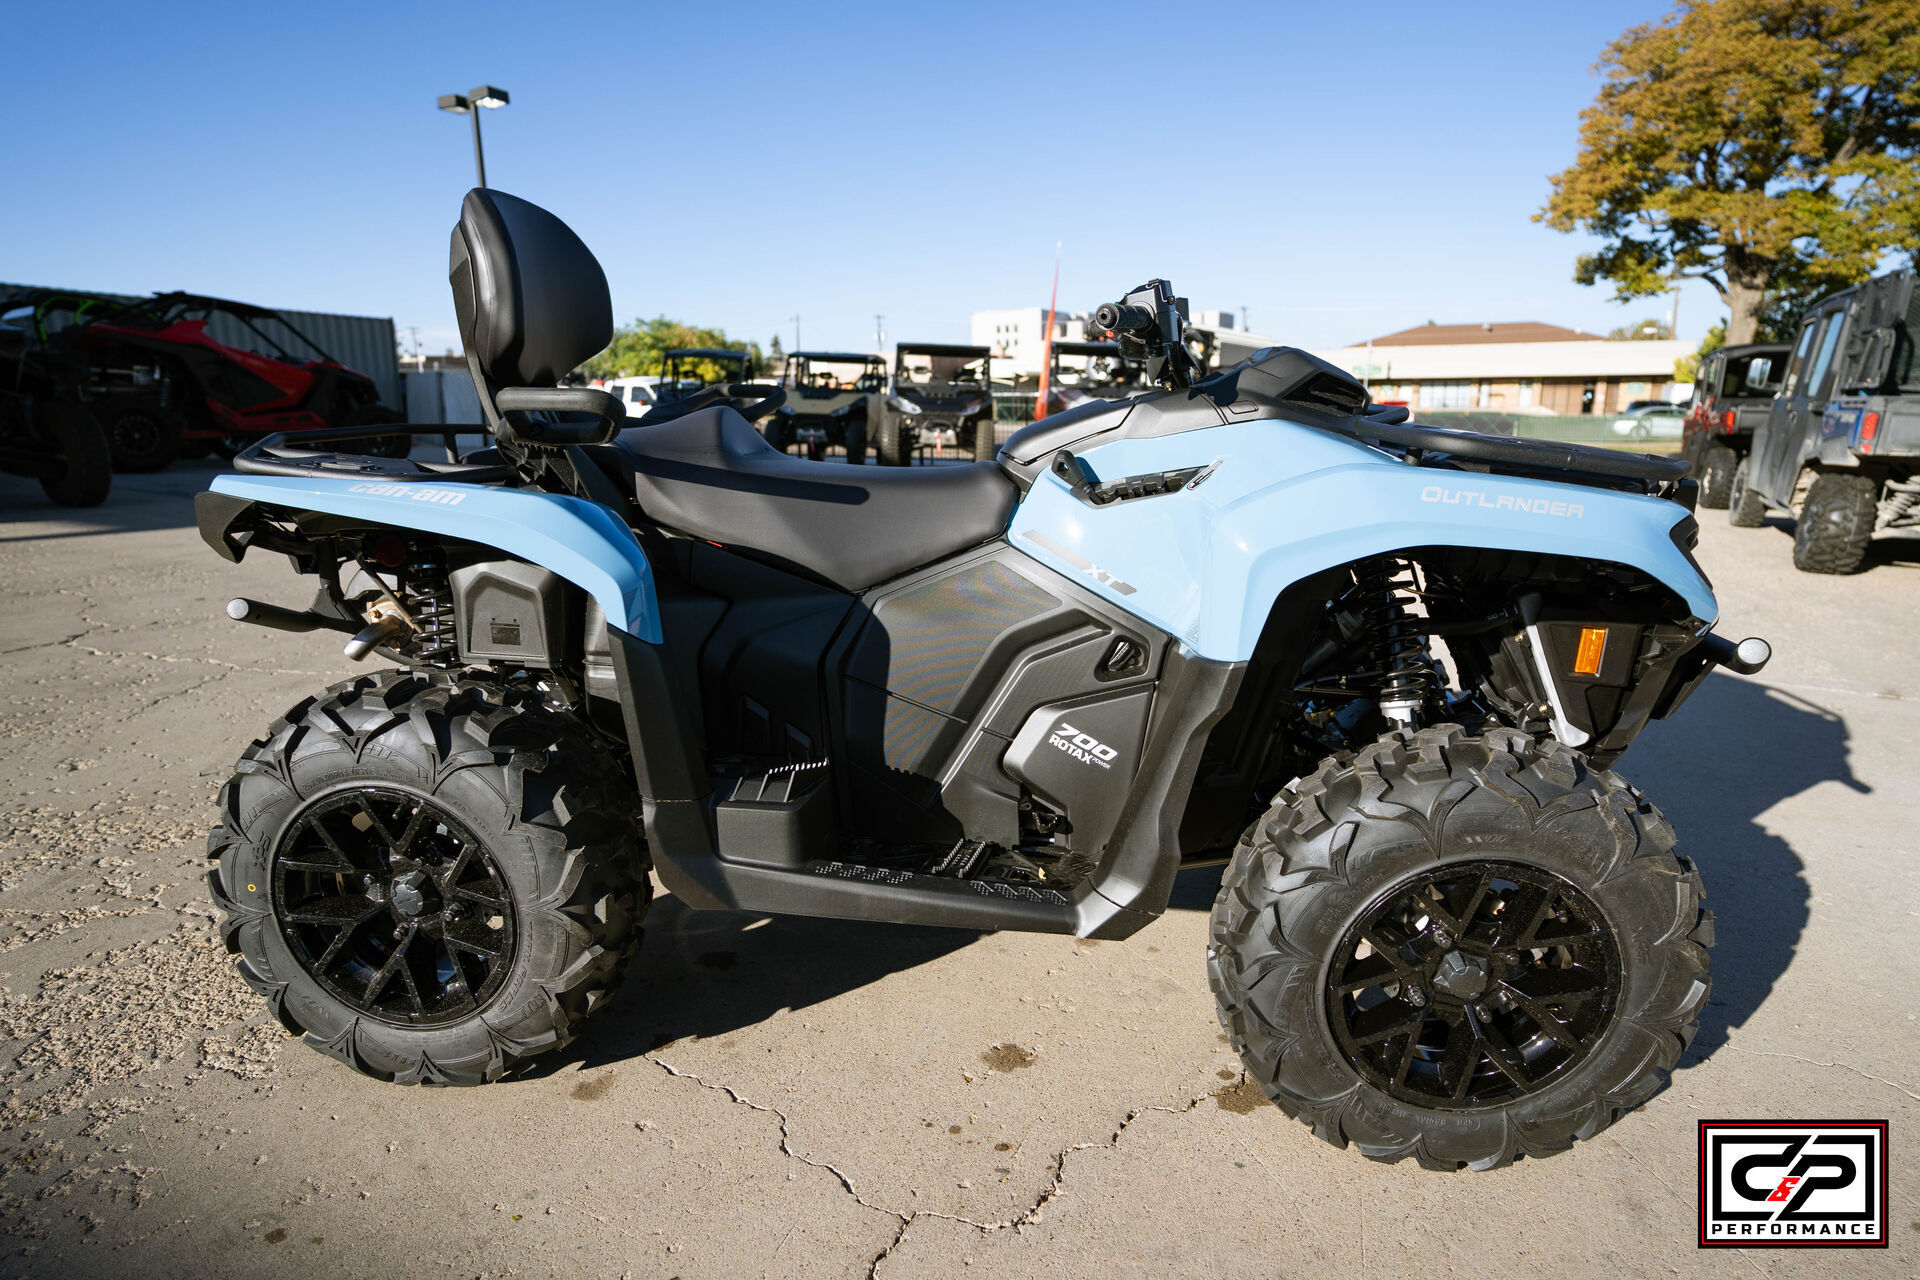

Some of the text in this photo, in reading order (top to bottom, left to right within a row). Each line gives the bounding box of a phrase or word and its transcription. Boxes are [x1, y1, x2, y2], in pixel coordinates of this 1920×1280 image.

[348, 483, 467, 506] can-am
[1420, 486, 1585, 519] OUTLANDER
[1083, 563, 1124, 587] XT
[1048, 733, 1111, 770] ROTAX POWER
[1054, 722, 1118, 761] 700
